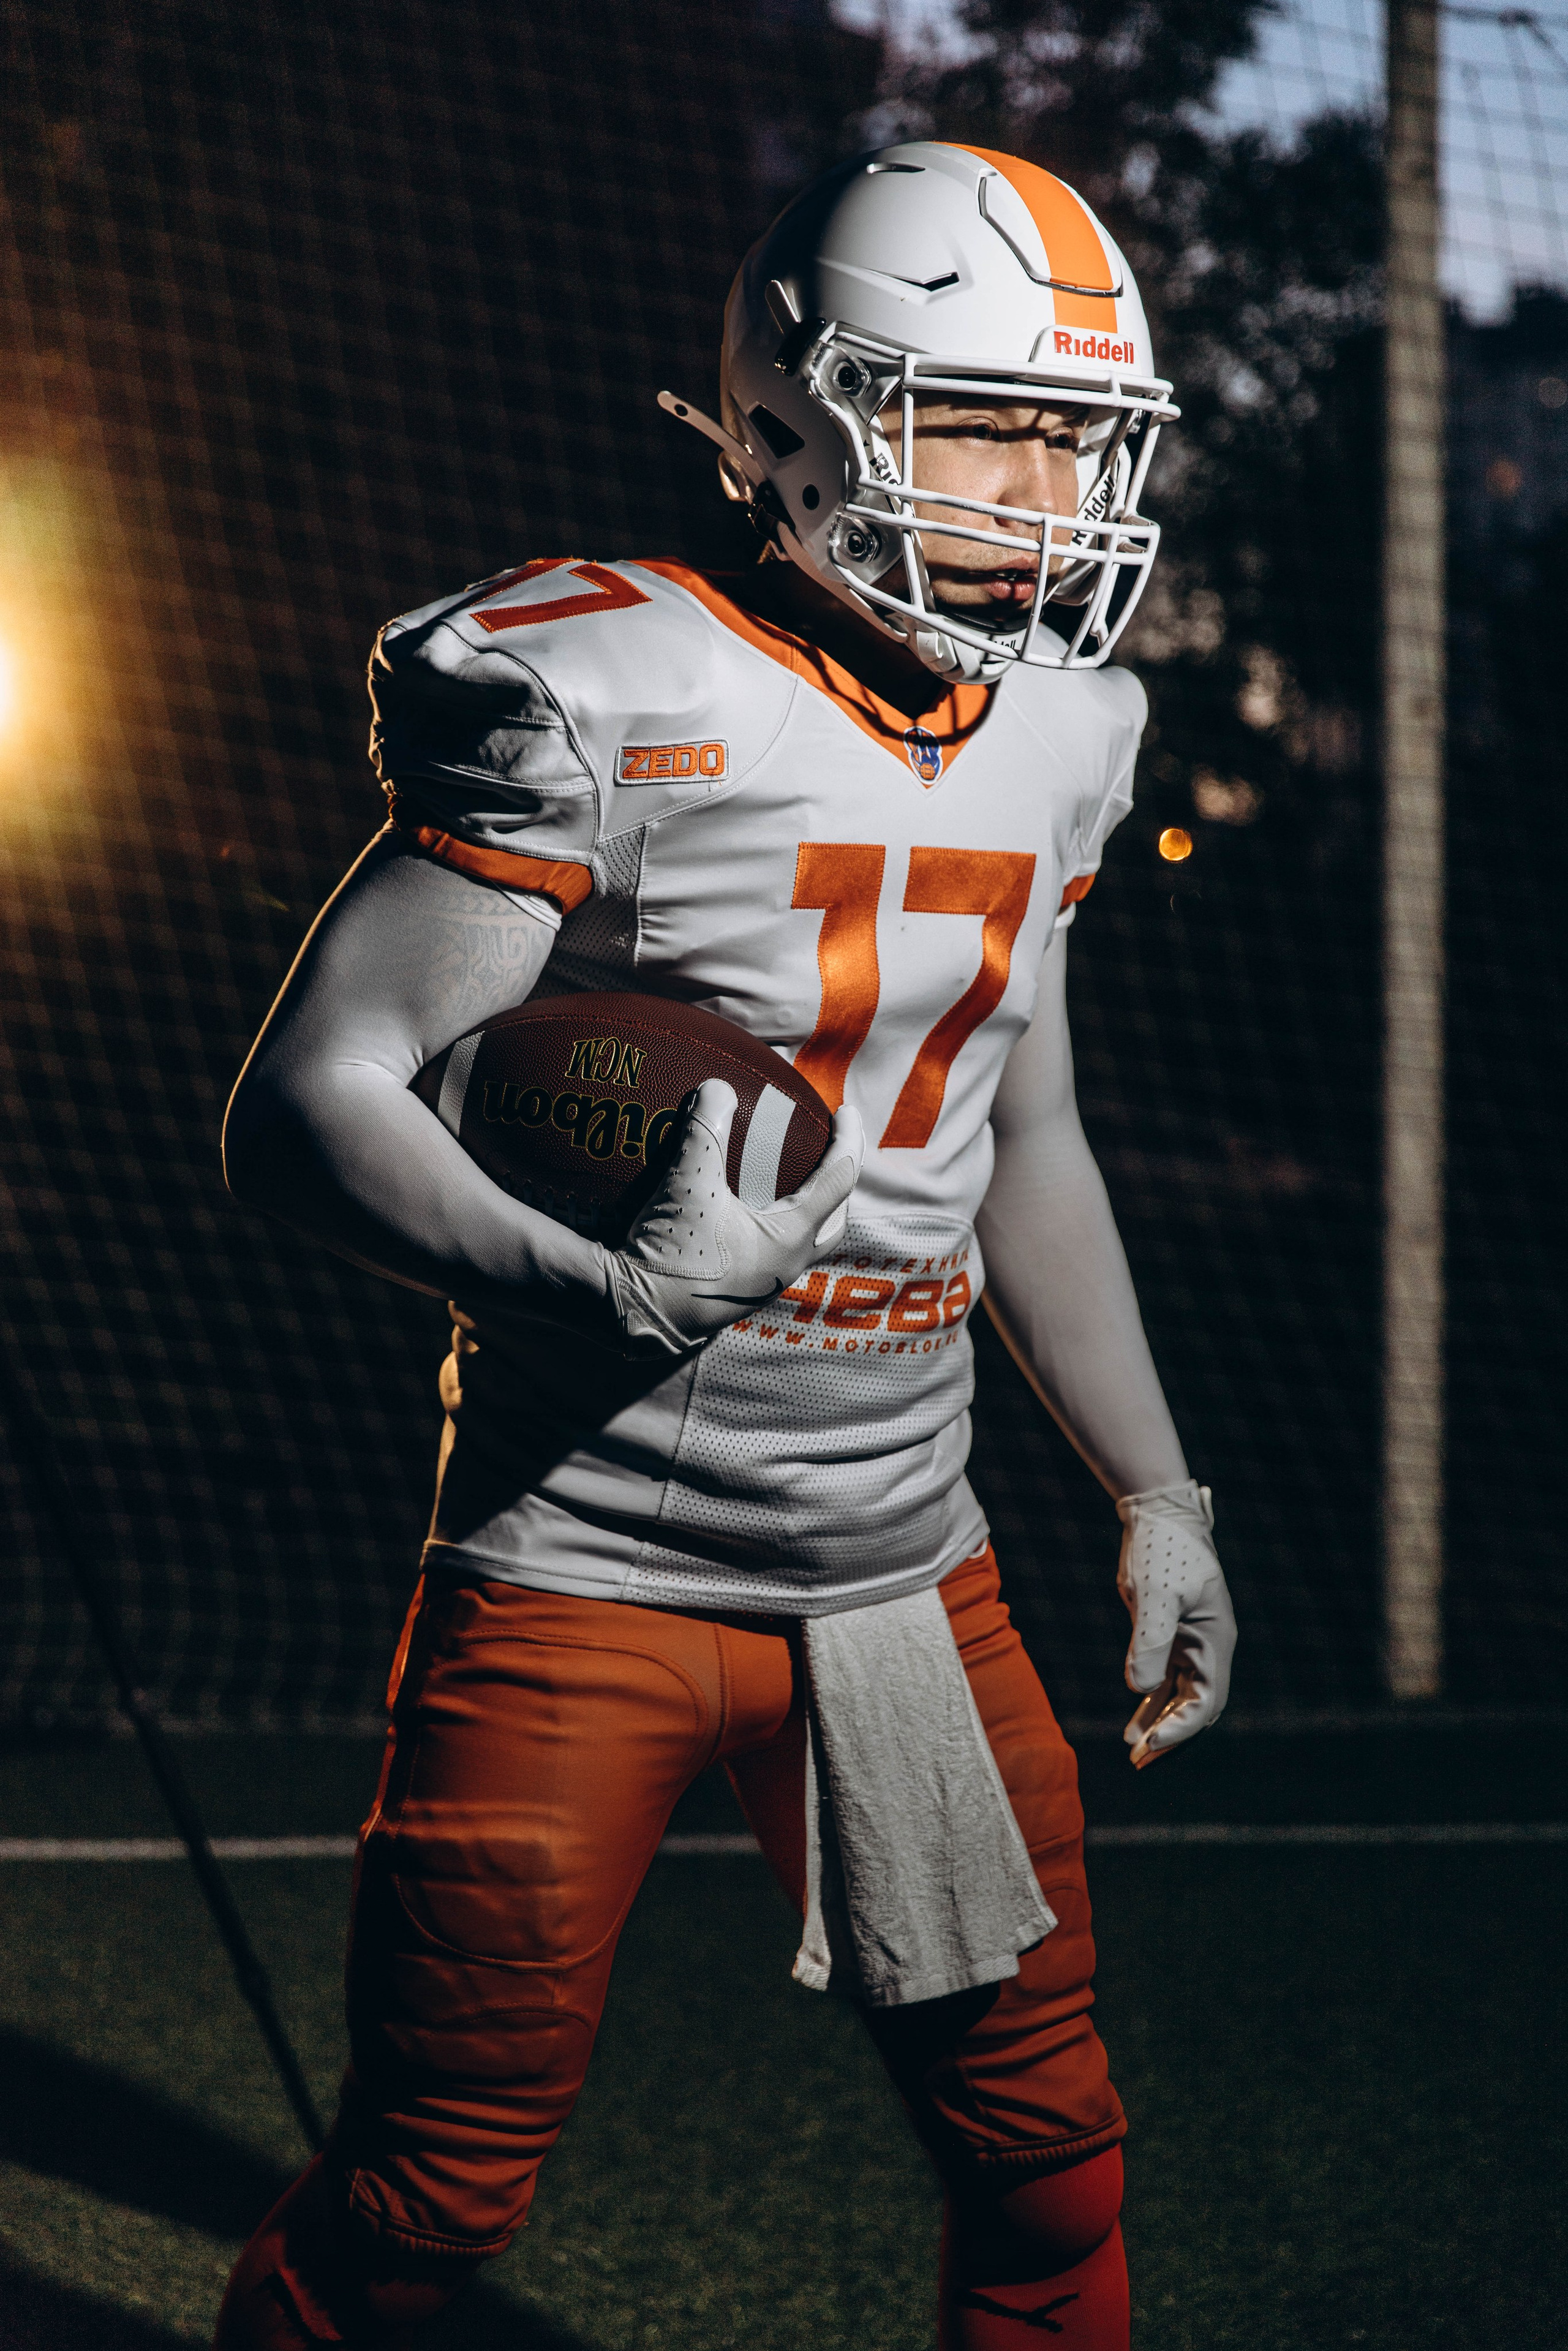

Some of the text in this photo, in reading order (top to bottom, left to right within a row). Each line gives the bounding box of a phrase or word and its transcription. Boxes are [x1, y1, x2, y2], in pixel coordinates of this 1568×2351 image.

[1054, 331, 1134, 364] Riddell
[1072, 474, 1115, 546] Rddell
[622, 743, 725, 780] ZEDO
[565, 1036, 647, 1089] NCM
